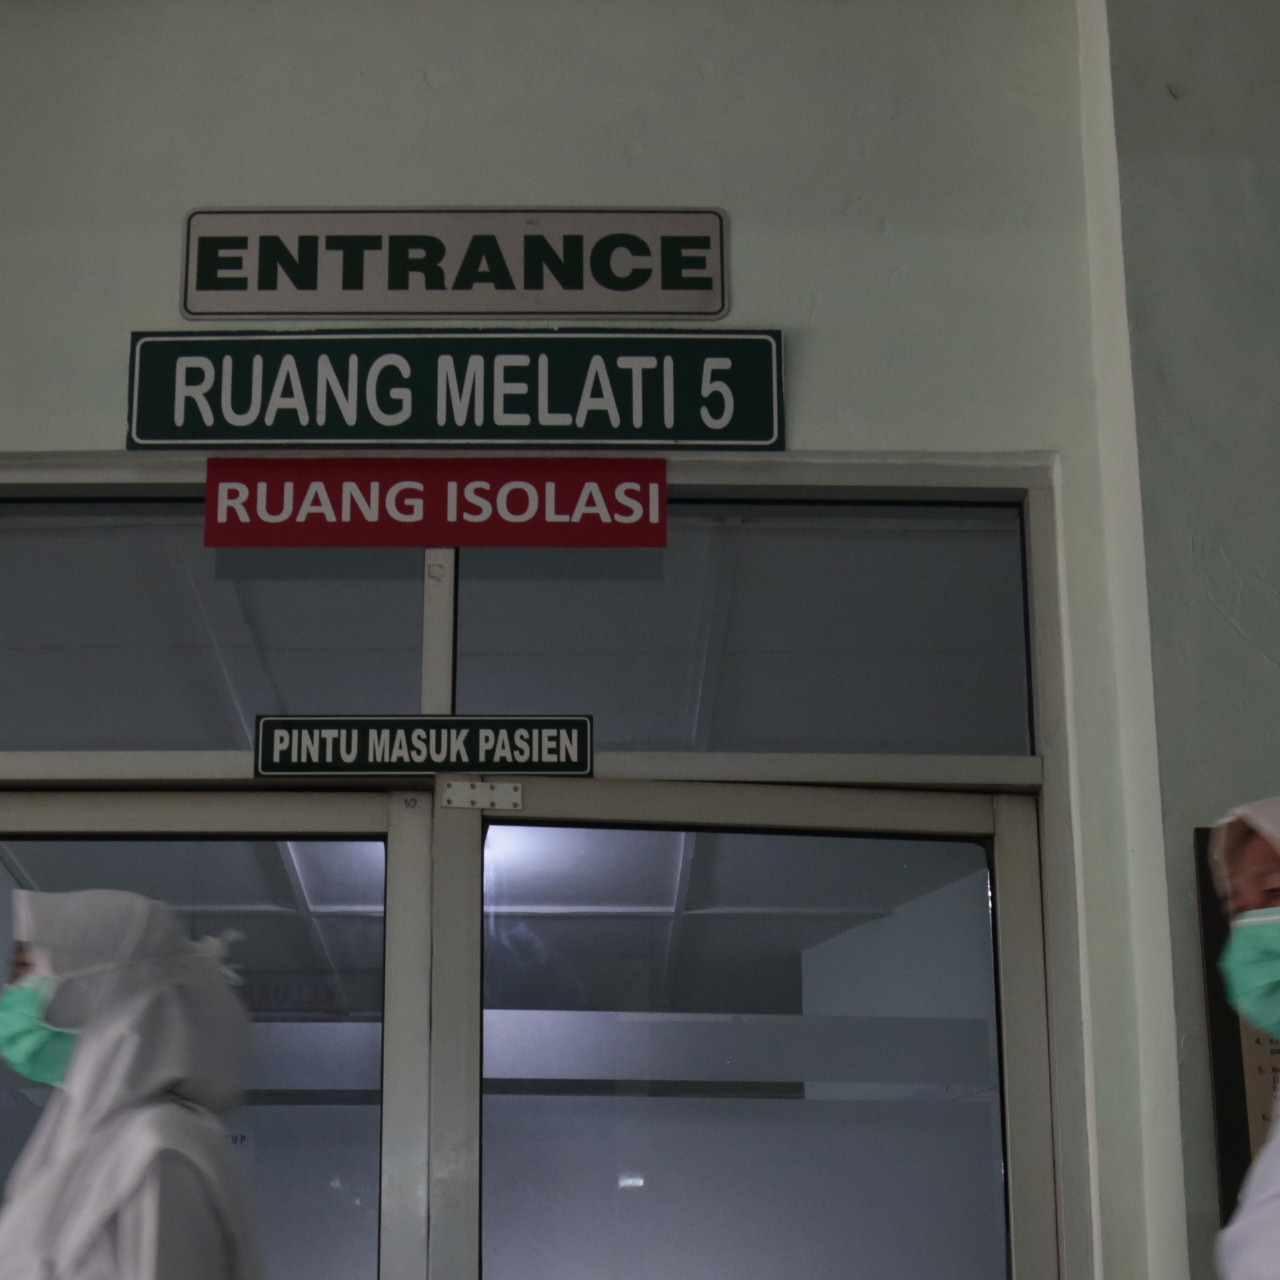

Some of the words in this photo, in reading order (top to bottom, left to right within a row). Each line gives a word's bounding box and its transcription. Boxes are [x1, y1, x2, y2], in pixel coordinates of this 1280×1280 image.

[196, 233, 713, 291] ENTRANCE
[174, 354, 412, 426] RUANG
[437, 354, 674, 428] MELATI
[700, 358, 734, 429] 5
[217, 481, 423, 523] RUANG
[447, 481, 659, 523] ISOLASI
[273, 729, 358, 763] PINTU
[368, 729, 469, 762] MASUK
[479, 729, 577, 762] PASIEN
